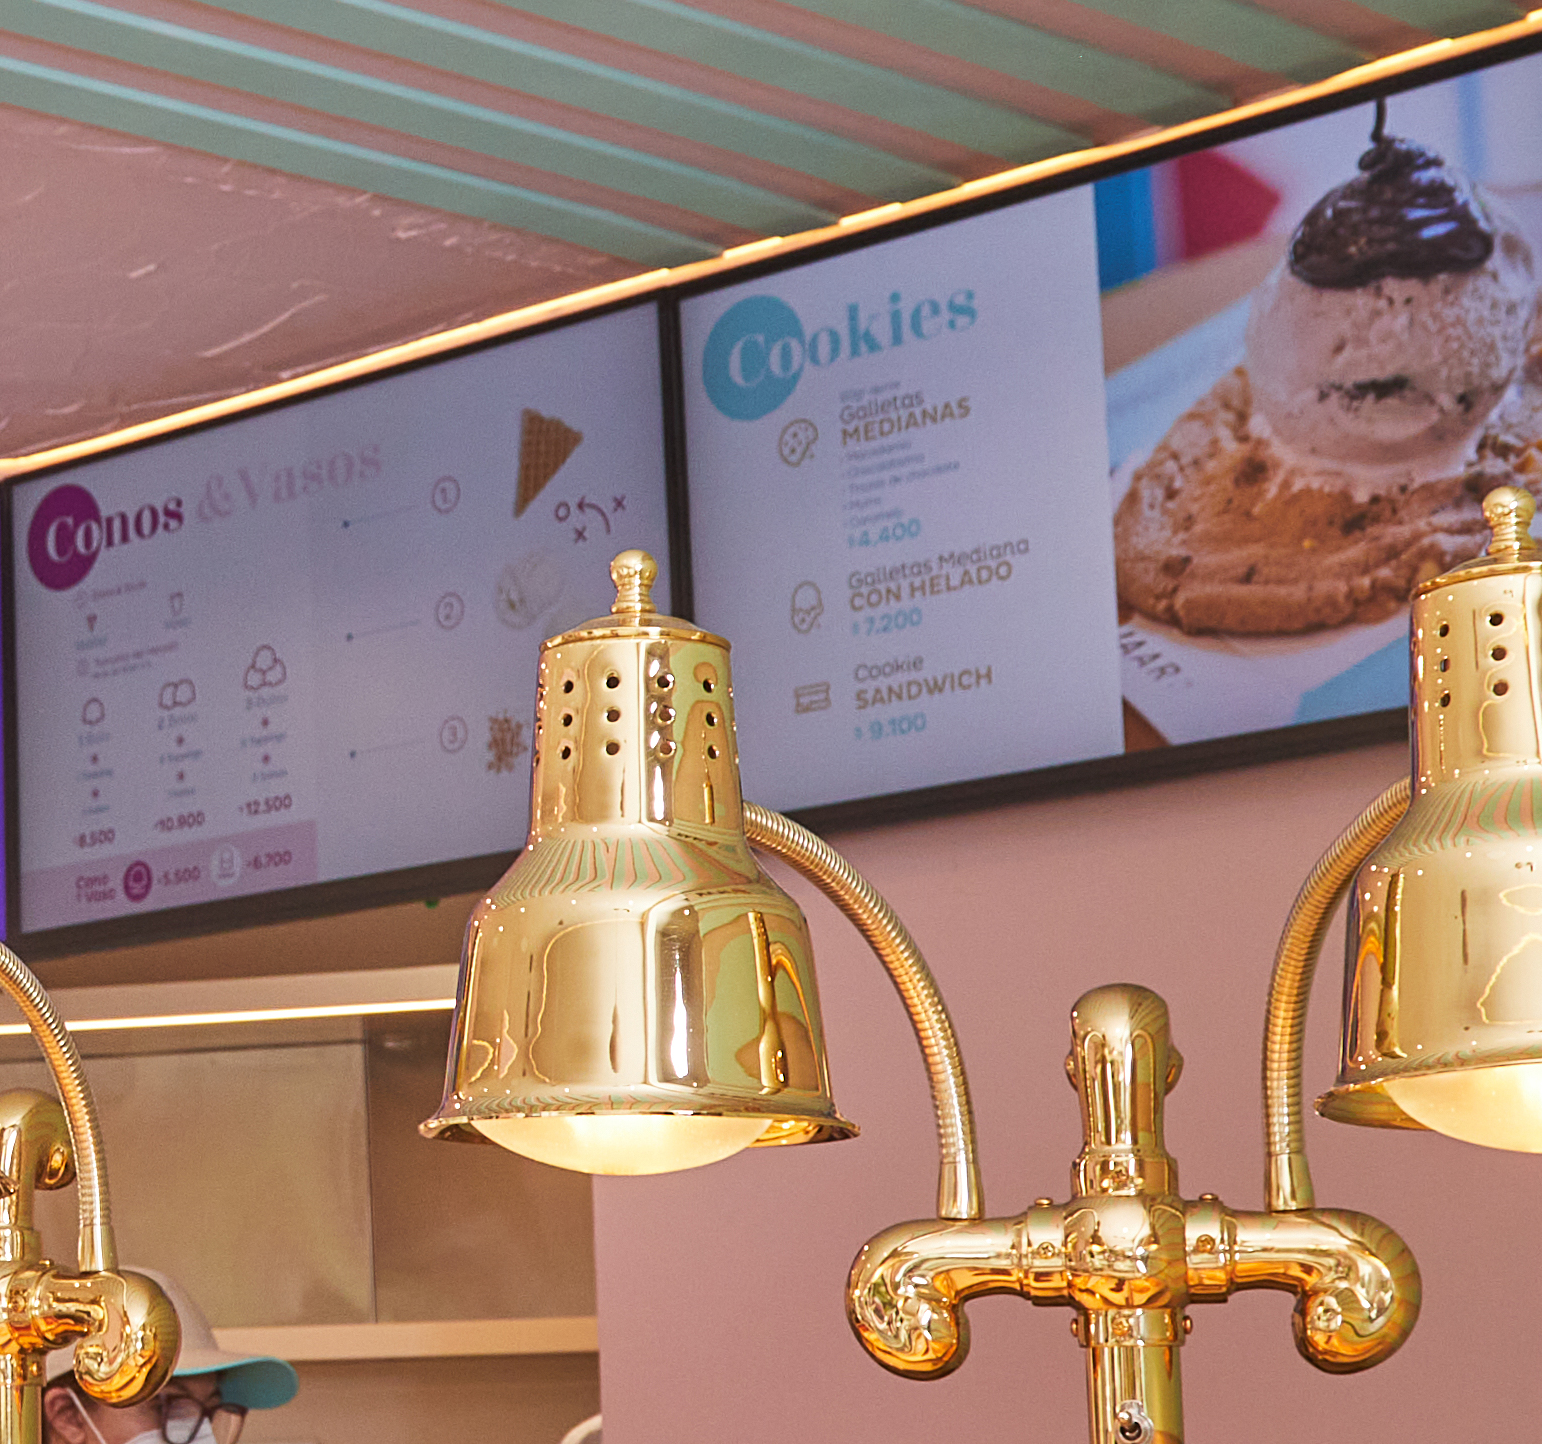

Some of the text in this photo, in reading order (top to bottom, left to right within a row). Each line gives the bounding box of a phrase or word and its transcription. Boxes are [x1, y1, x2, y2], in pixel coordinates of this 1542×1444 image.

[729, 289, 978, 387] Cookies
[839, 391, 924, 424] Galletas
[841, 396, 971, 445] MEDIANAS
[45, 496, 184, 564] Conos
[848, 538, 1029, 590] Galletas Mediana
[850, 560, 1012, 612] CON HELADO
[854, 655, 924, 683] Cookie
[855, 665, 993, 710] SANDWICH
